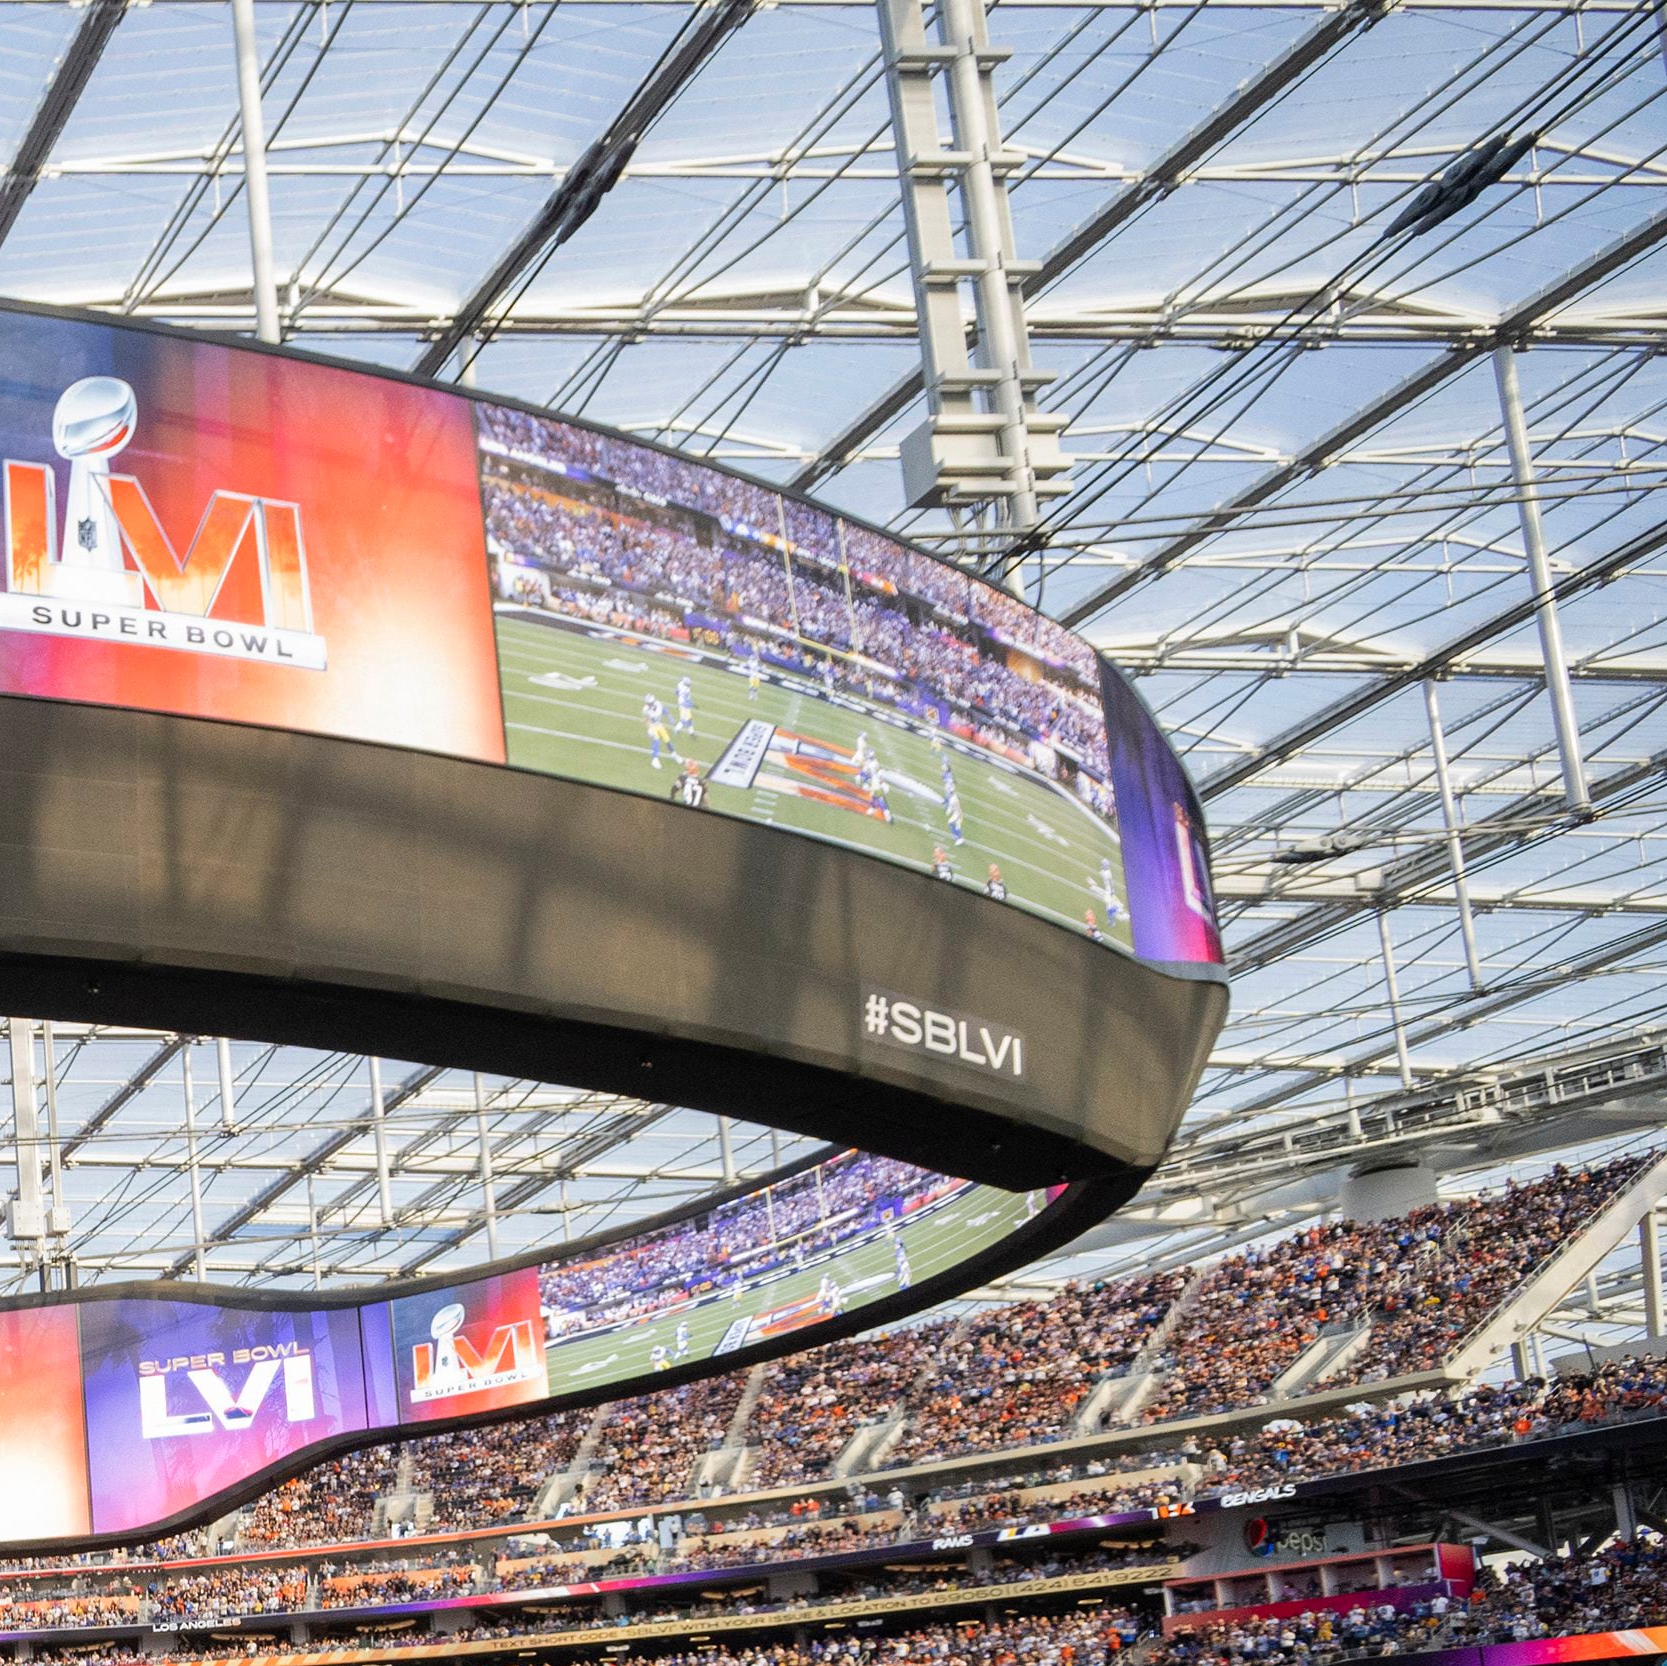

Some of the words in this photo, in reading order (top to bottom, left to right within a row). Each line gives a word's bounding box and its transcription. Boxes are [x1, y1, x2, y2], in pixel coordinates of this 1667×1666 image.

[2, 458, 312, 631] LVI
[29, 600, 165, 640] SUPER
[186, 625, 297, 662] BOWL
[862, 992, 1023, 1078] #SBLVI
[139, 1353, 224, 1379] SUPER
[233, 1340, 311, 1365] BOWL
[411, 1320, 542, 1395] LVI
[139, 1358, 315, 1440] LVI
[1221, 1484, 1297, 1507] BENGALS
[933, 1534, 974, 1551] RAMS
[1072, 1565, 1174, 1589] 541-9222
[529, 1635, 575, 1647] SHORT
[579, 1630, 617, 1642] CODE
[677, 1619, 719, 1631] WITH
[768, 1612, 812, 1624] ISSUE
[829, 1599, 907, 1617] LOCATION
